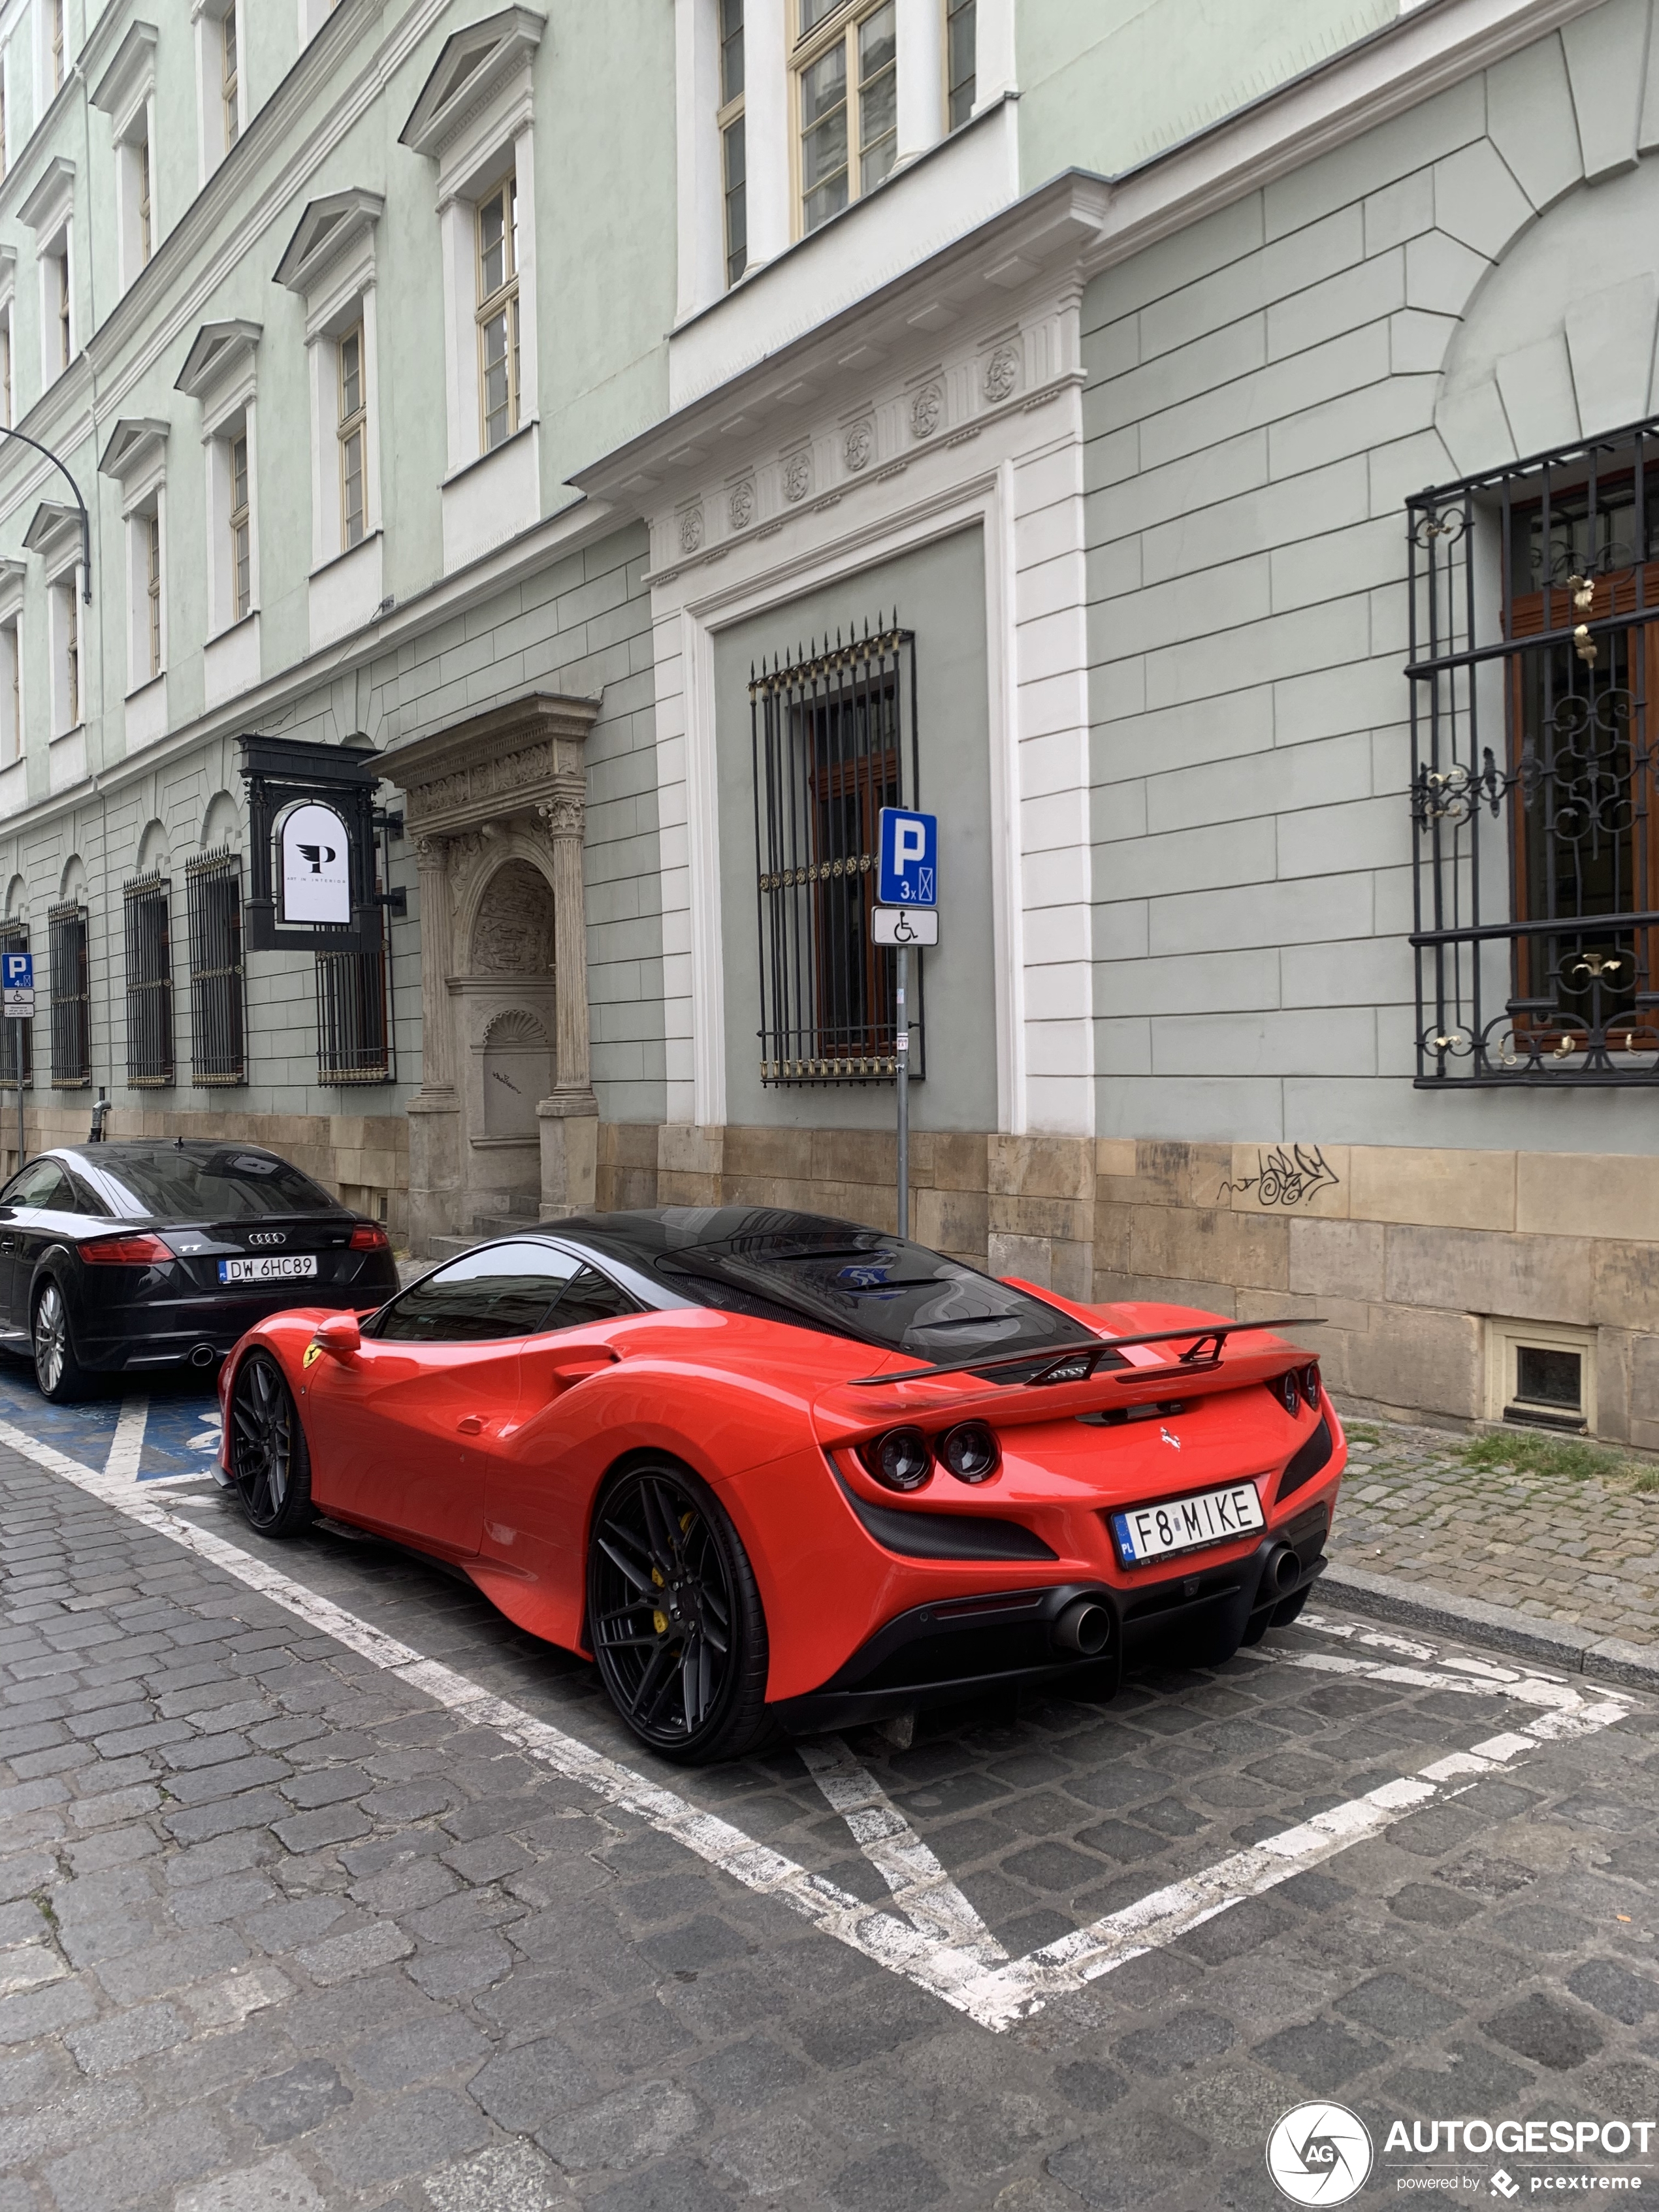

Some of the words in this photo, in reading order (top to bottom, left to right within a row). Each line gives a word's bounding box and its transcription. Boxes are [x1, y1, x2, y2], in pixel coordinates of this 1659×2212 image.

[894, 818, 926, 876] P
[8, 957, 26, 978] P
[231, 1260, 253, 1278] DW
[261, 1258, 312, 1275] 6HC89
[1135, 1510, 1174, 1553] F8
[1181, 1490, 1252, 1540] MIKE
[1121, 1543, 1133, 1555] PL
